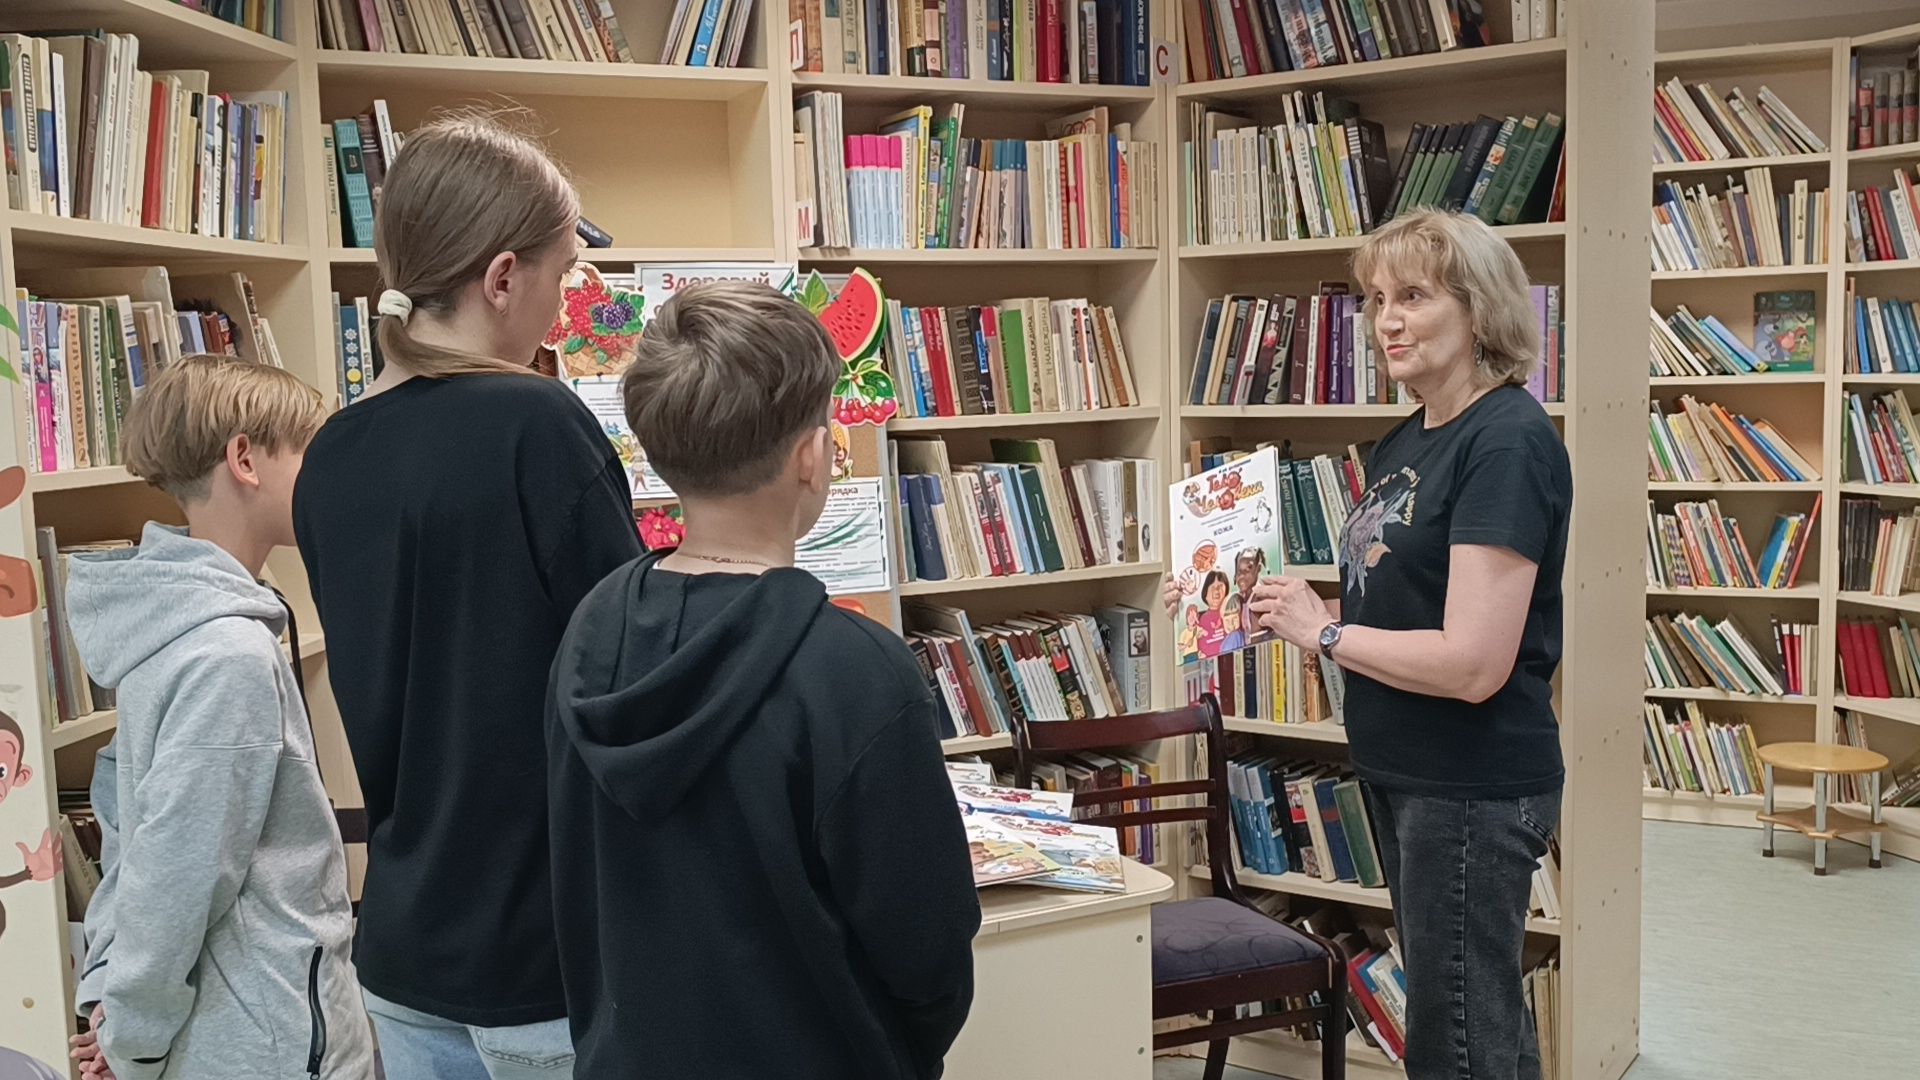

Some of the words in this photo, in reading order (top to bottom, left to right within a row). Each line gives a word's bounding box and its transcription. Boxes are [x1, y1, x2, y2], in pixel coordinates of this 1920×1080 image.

[1156, 44, 1169, 77] С
[797, 207, 811, 240] М
[1041, 306, 1051, 365] НАДЕЖДИНА
[829, 487, 858, 497] рядка
[1213, 525, 1233, 536] КОЖА
